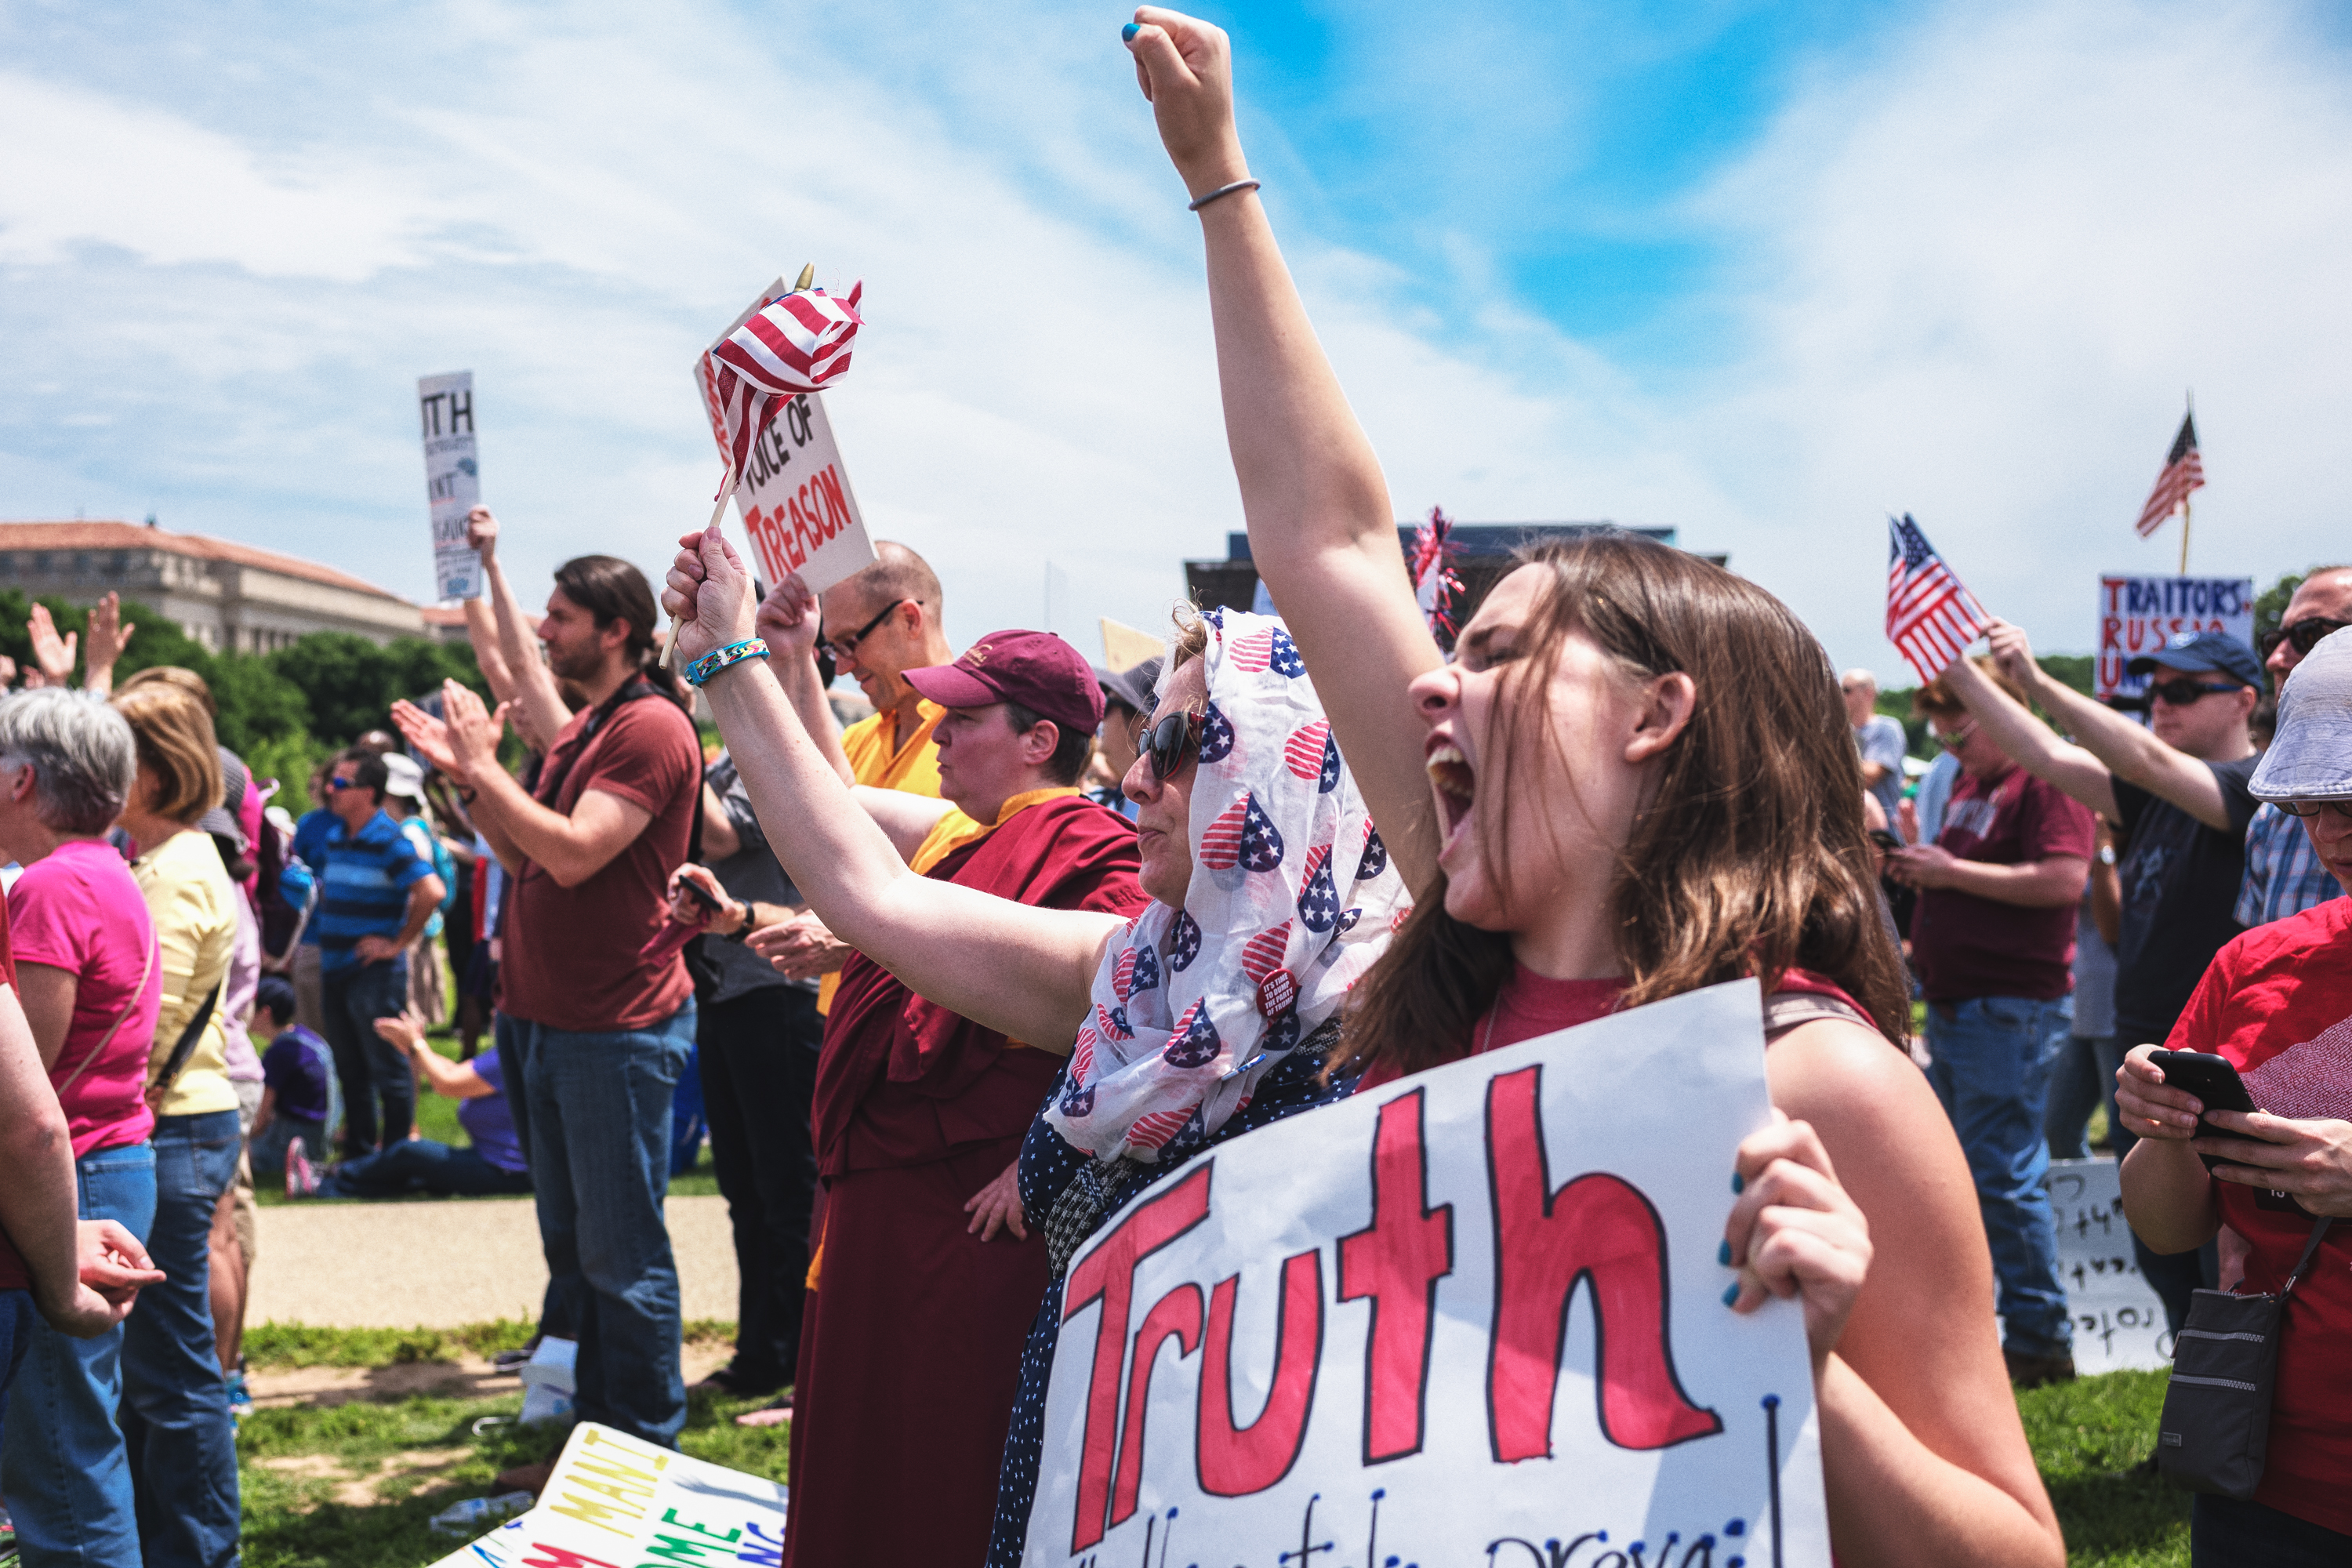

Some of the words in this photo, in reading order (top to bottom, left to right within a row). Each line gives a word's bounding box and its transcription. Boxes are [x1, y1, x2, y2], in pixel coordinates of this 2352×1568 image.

[745, 415, 791, 495] OICE
[786, 393, 814, 448] OF
[744, 463, 852, 584] TREASON
[1263, 982, 1275, 993] IT'S
[1274, 972, 1288, 985] TIME
[1265, 992, 1274, 1001] TO
[1273, 980, 1290, 996] DUMP
[1265, 999, 1276, 1010] THE
[1276, 987, 1293, 1004] PARTY
[1267, 1007, 1275, 1017] OF
[1275, 995, 1294, 1012] TRUMP
[1061, 1062, 1725, 1558] Truth
